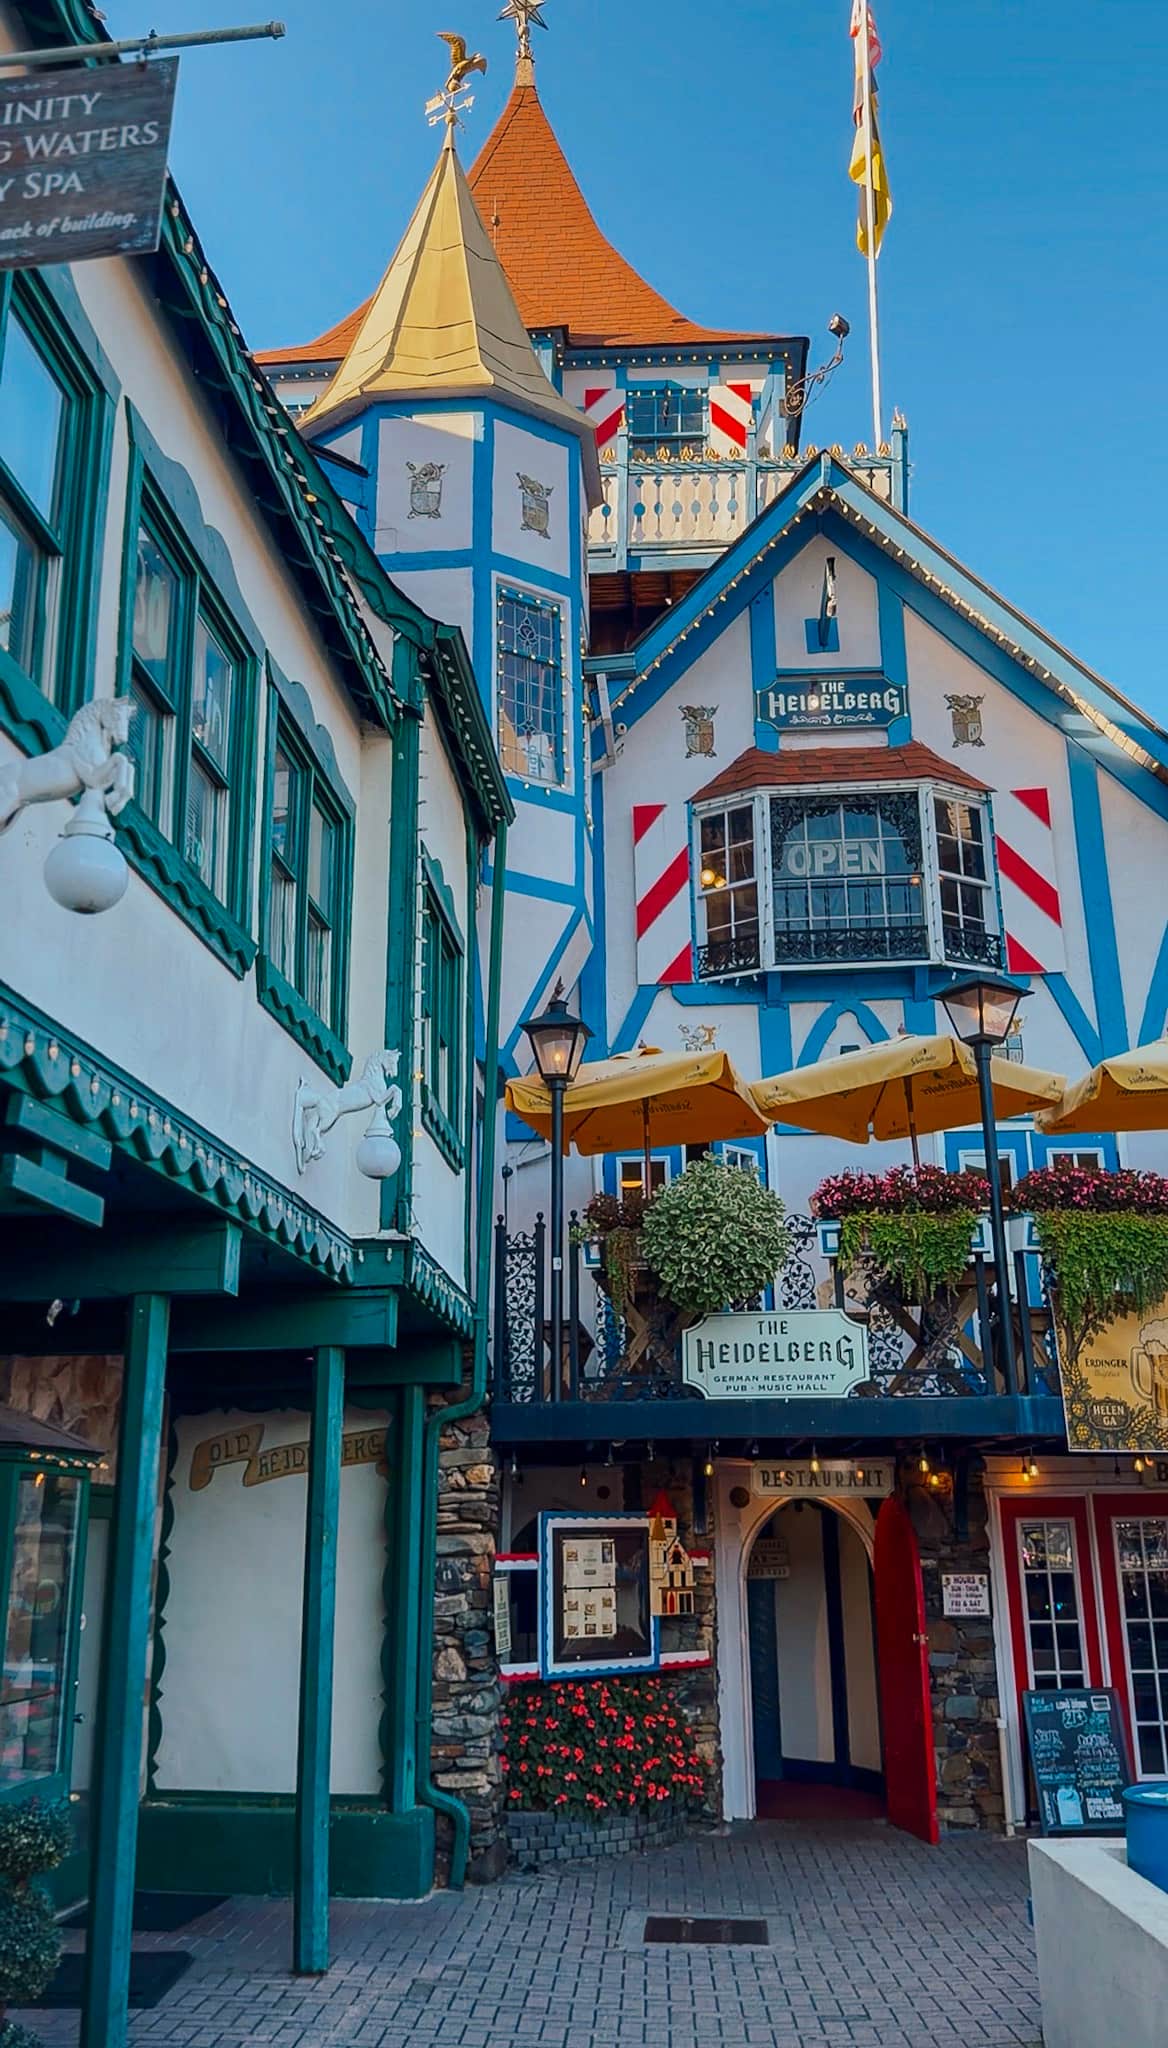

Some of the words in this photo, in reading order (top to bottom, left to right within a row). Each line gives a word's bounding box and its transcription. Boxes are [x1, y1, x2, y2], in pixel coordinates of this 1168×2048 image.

[24, 121, 160, 159] WATERS
[22, 171, 85, 199] SPA
[36, 218, 61, 237] of
[60, 211, 138, 233] building.
[820, 682, 845, 693] THE
[768, 688, 900, 719] HEIDELBERG
[786, 841, 886, 876] OPEN
[758, 1320, 789, 1335] THE
[696, 1335, 854, 1372] HEIDELBERG
[1085, 1357, 1128, 1368] ERDINGER
[714, 1374, 759, 1383] GERMAN
[763, 1373, 836, 1382] RESTAURANT
[758, 1384, 792, 1392] MUSIC
[796, 1383, 827, 1391] HALL
[1093, 1404, 1125, 1416] HELEN
[1103, 1416, 1117, 1426] GA
[209, 1434, 250, 1462] OLD
[761, 1469, 883, 1487] RESTAURANT
[953, 1576, 976, 1584] HOURS
